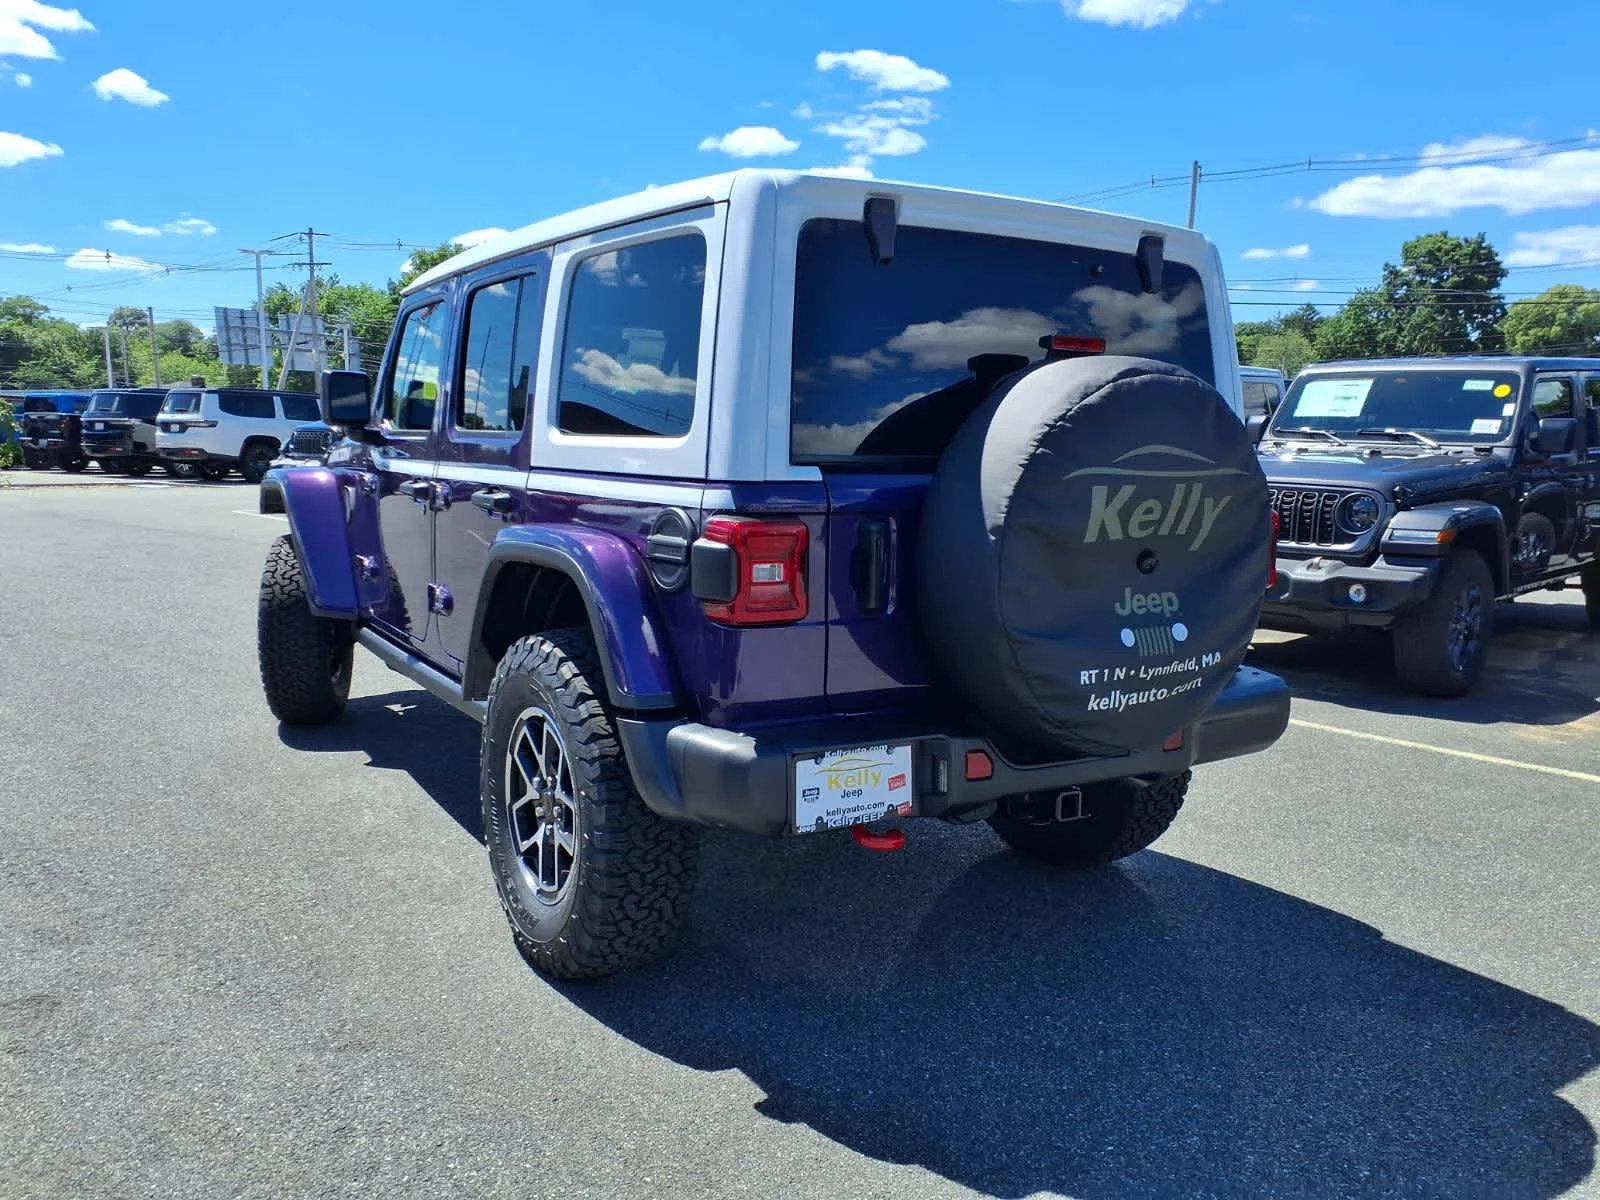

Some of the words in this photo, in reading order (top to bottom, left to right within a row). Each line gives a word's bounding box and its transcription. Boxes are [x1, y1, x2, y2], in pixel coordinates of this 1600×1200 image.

[1083, 483, 1232, 551] Kelly
[1114, 587, 1179, 617] Jeep
[1080, 669, 1099, 685] RT
[1103, 669, 1110, 682] 1
[1114, 667, 1127, 681] N
[1139, 657, 1199, 680] Lynnfield,
[1201, 652, 1221, 668] MA
[1087, 676, 1203, 712] kellyauto.com
[827, 769, 882, 791] Kelly
[840, 788, 863, 799] Jeep
[826, 801, 885, 817] kellyauto.com
[828, 815, 855, 829] Kelly
